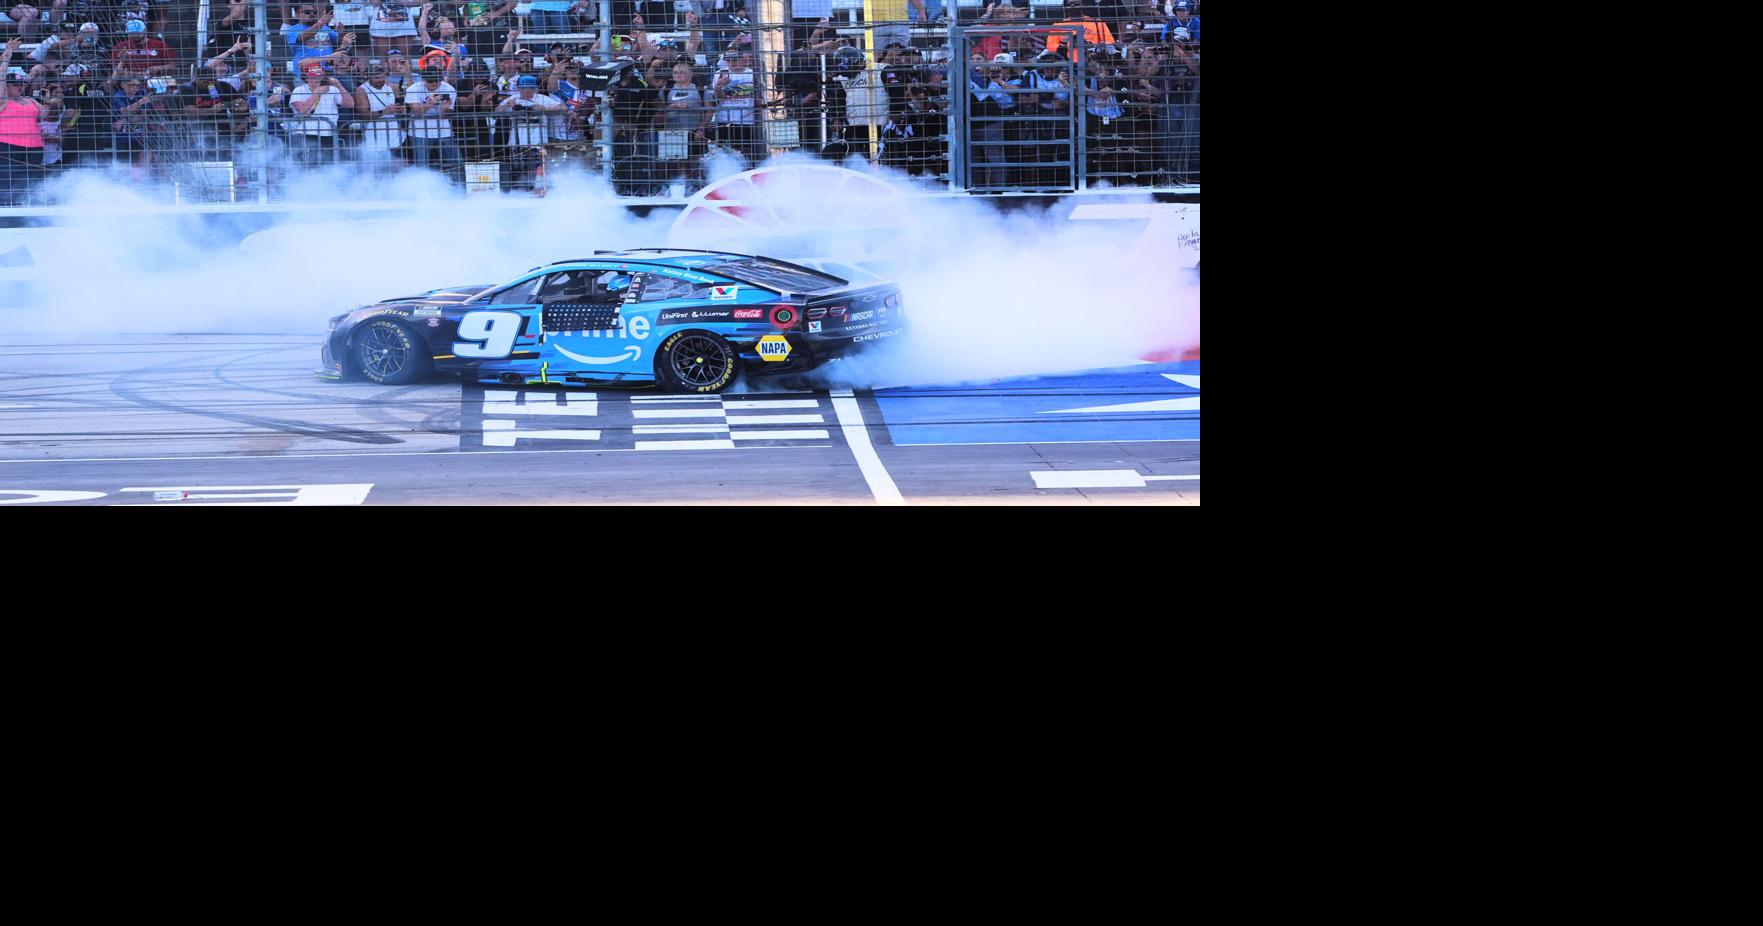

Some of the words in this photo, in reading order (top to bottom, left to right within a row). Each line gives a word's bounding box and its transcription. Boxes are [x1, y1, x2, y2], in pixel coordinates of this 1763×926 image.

[661, 312, 689, 320] UniFirst
[452, 311, 522, 358] 9
[664, 331, 682, 352] EAGLE
[761, 342, 787, 354] NAPA
[697, 357, 734, 392] GOODYEAR
